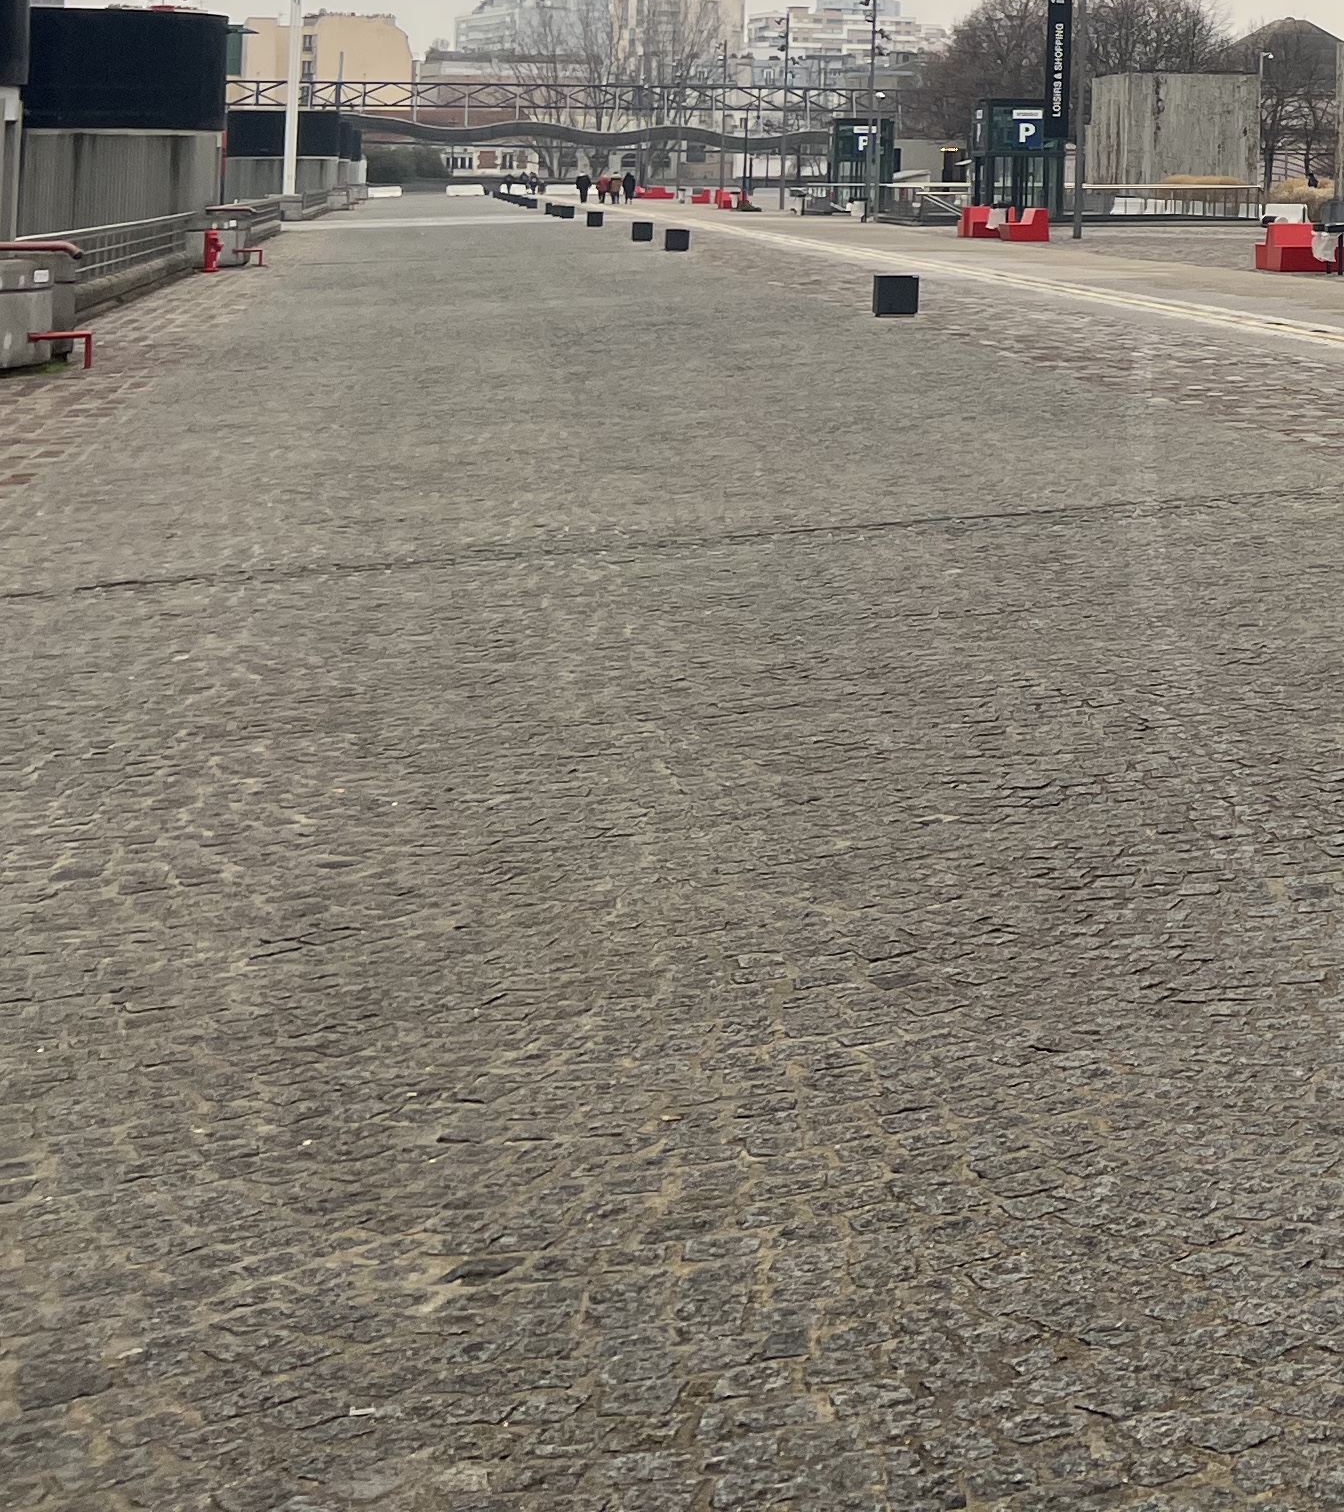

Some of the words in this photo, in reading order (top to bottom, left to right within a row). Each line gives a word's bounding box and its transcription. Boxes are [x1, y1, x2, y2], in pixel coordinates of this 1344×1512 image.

[1053, 23, 1064, 71] SHOPPING
[1052, 81, 1062, 117] LOISIRS
[1018, 123, 1036, 143] P
